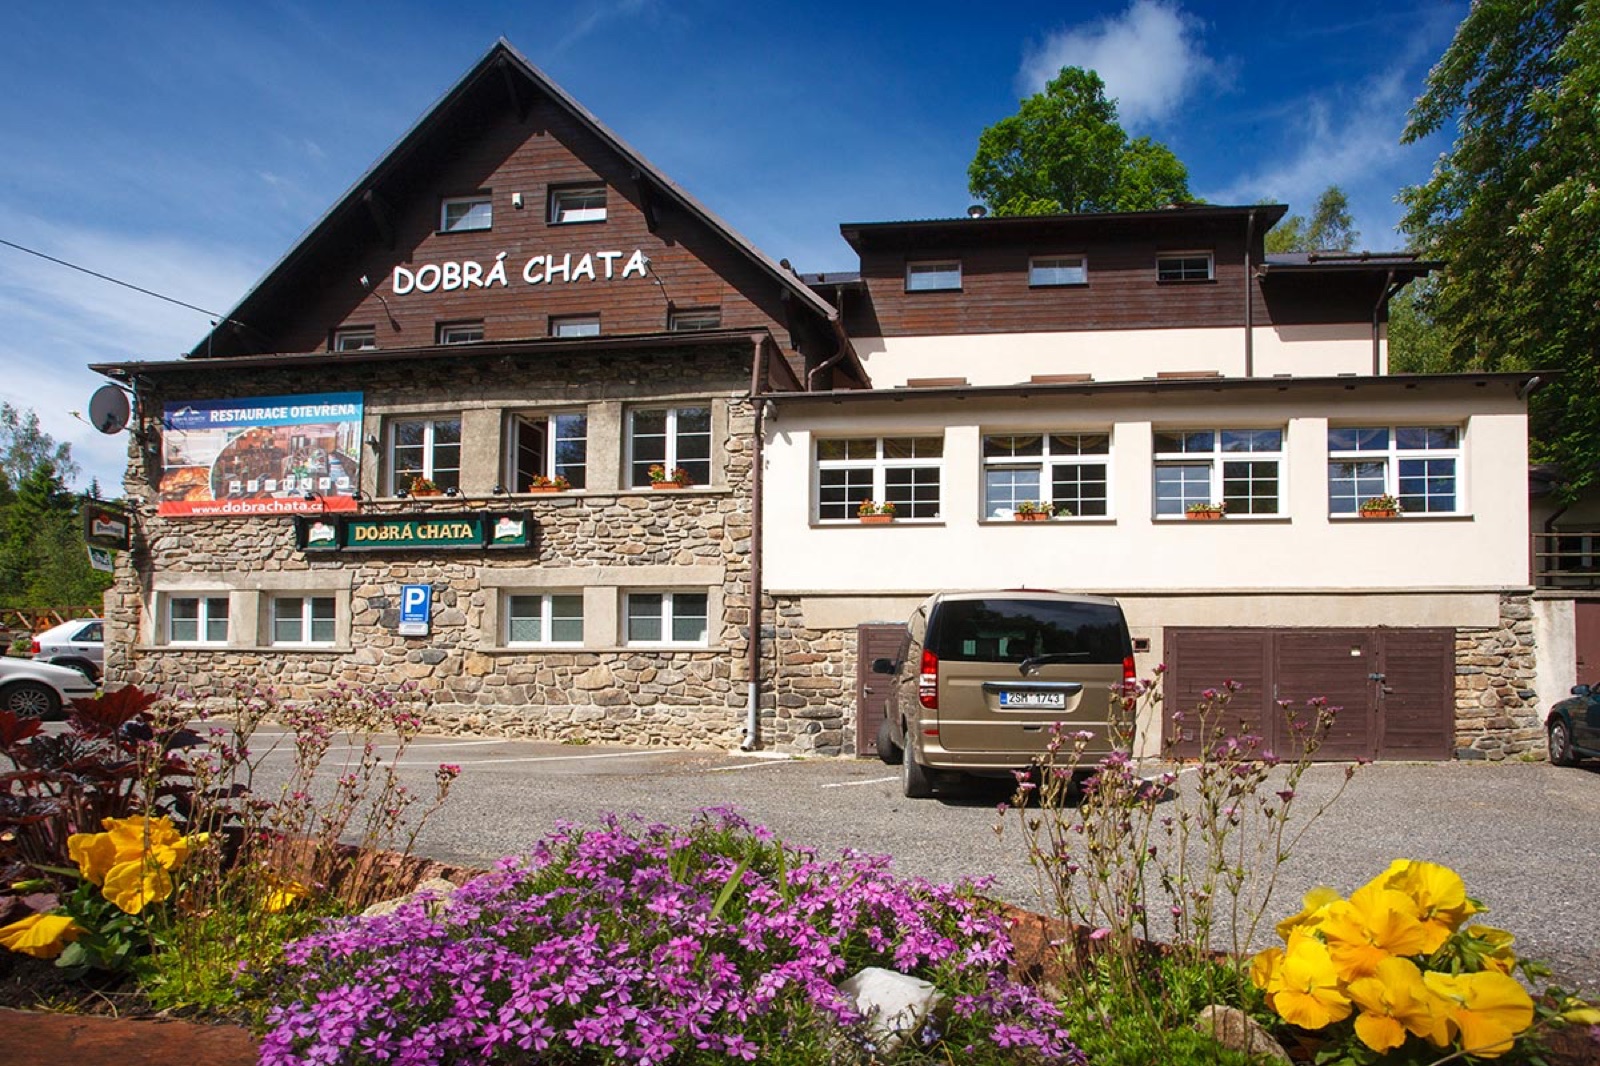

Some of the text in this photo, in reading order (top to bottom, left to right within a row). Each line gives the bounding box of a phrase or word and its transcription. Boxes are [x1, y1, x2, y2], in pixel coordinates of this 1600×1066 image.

[393, 249, 647, 295] DOBRÁ CHATA
[210, 405, 288, 422] RESTAURACE
[191, 500, 323, 514] www.dobrachata.cz
[355, 522, 474, 541] DOBRÁ CHATA
[405, 588, 425, 613] P
